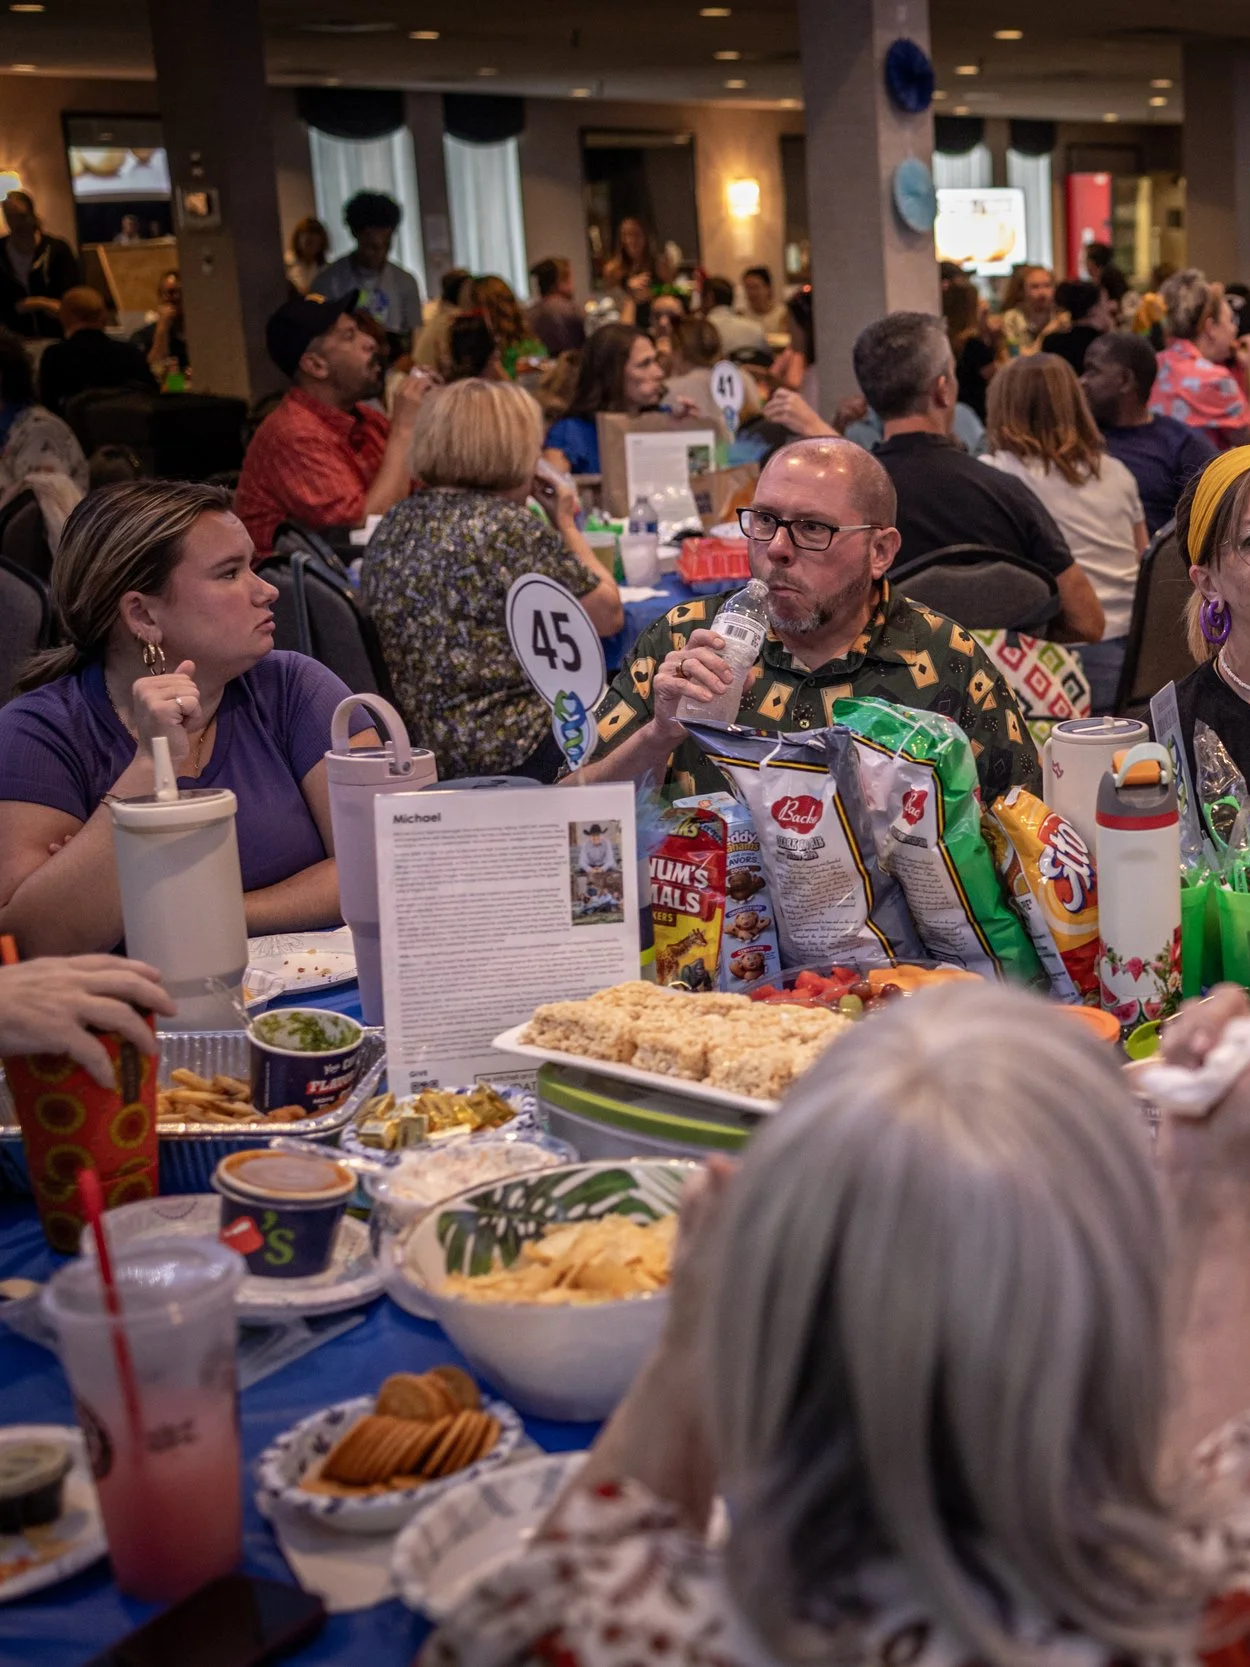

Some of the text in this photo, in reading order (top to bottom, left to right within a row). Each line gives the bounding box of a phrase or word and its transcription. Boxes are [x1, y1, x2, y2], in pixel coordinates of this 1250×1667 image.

[717, 374, 734, 398] 41
[531, 609, 582, 673] 45
[392, 812, 442, 825] Michael
